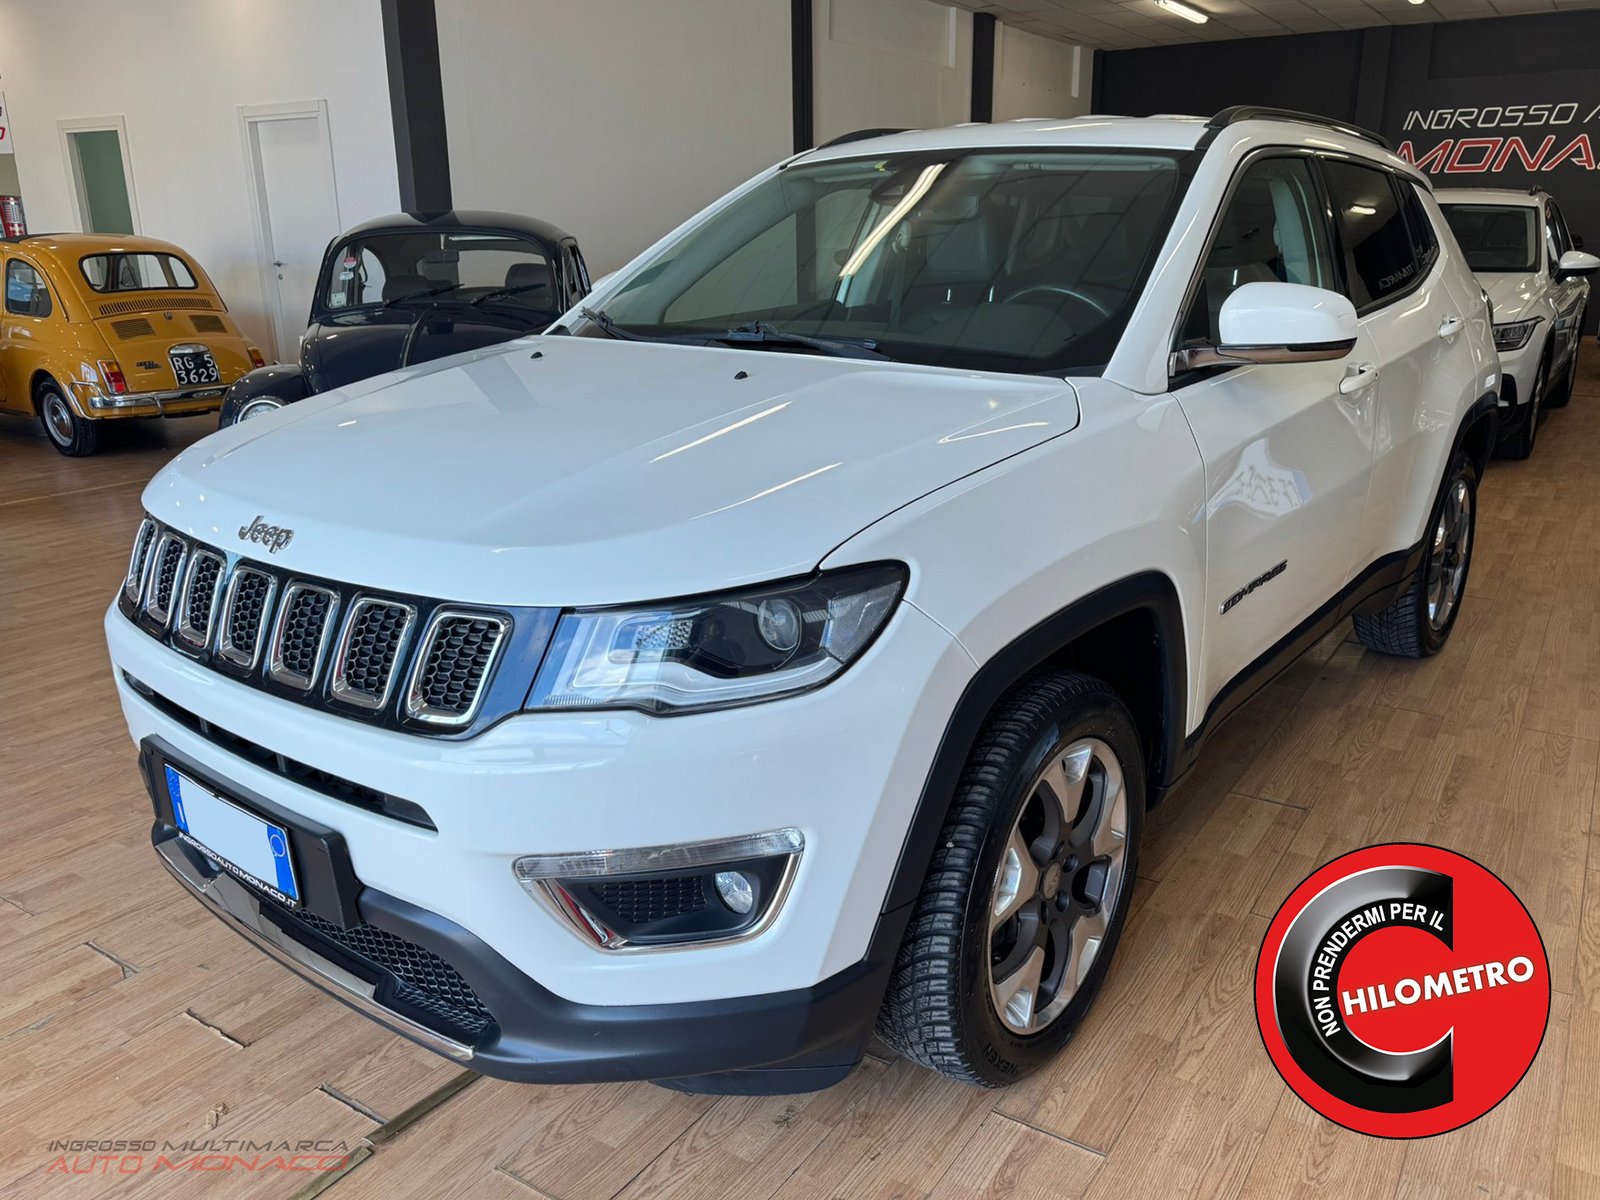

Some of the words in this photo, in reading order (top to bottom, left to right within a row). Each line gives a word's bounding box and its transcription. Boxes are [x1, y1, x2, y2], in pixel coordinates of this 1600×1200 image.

[1402, 102, 1579, 131] INGROSSO
[1396, 133, 1600, 175] MONA
[172, 356, 195, 371] RG
[203, 353, 214, 367] 5
[177, 368, 217, 384] 3629
[238, 514, 294, 554] Jeep
